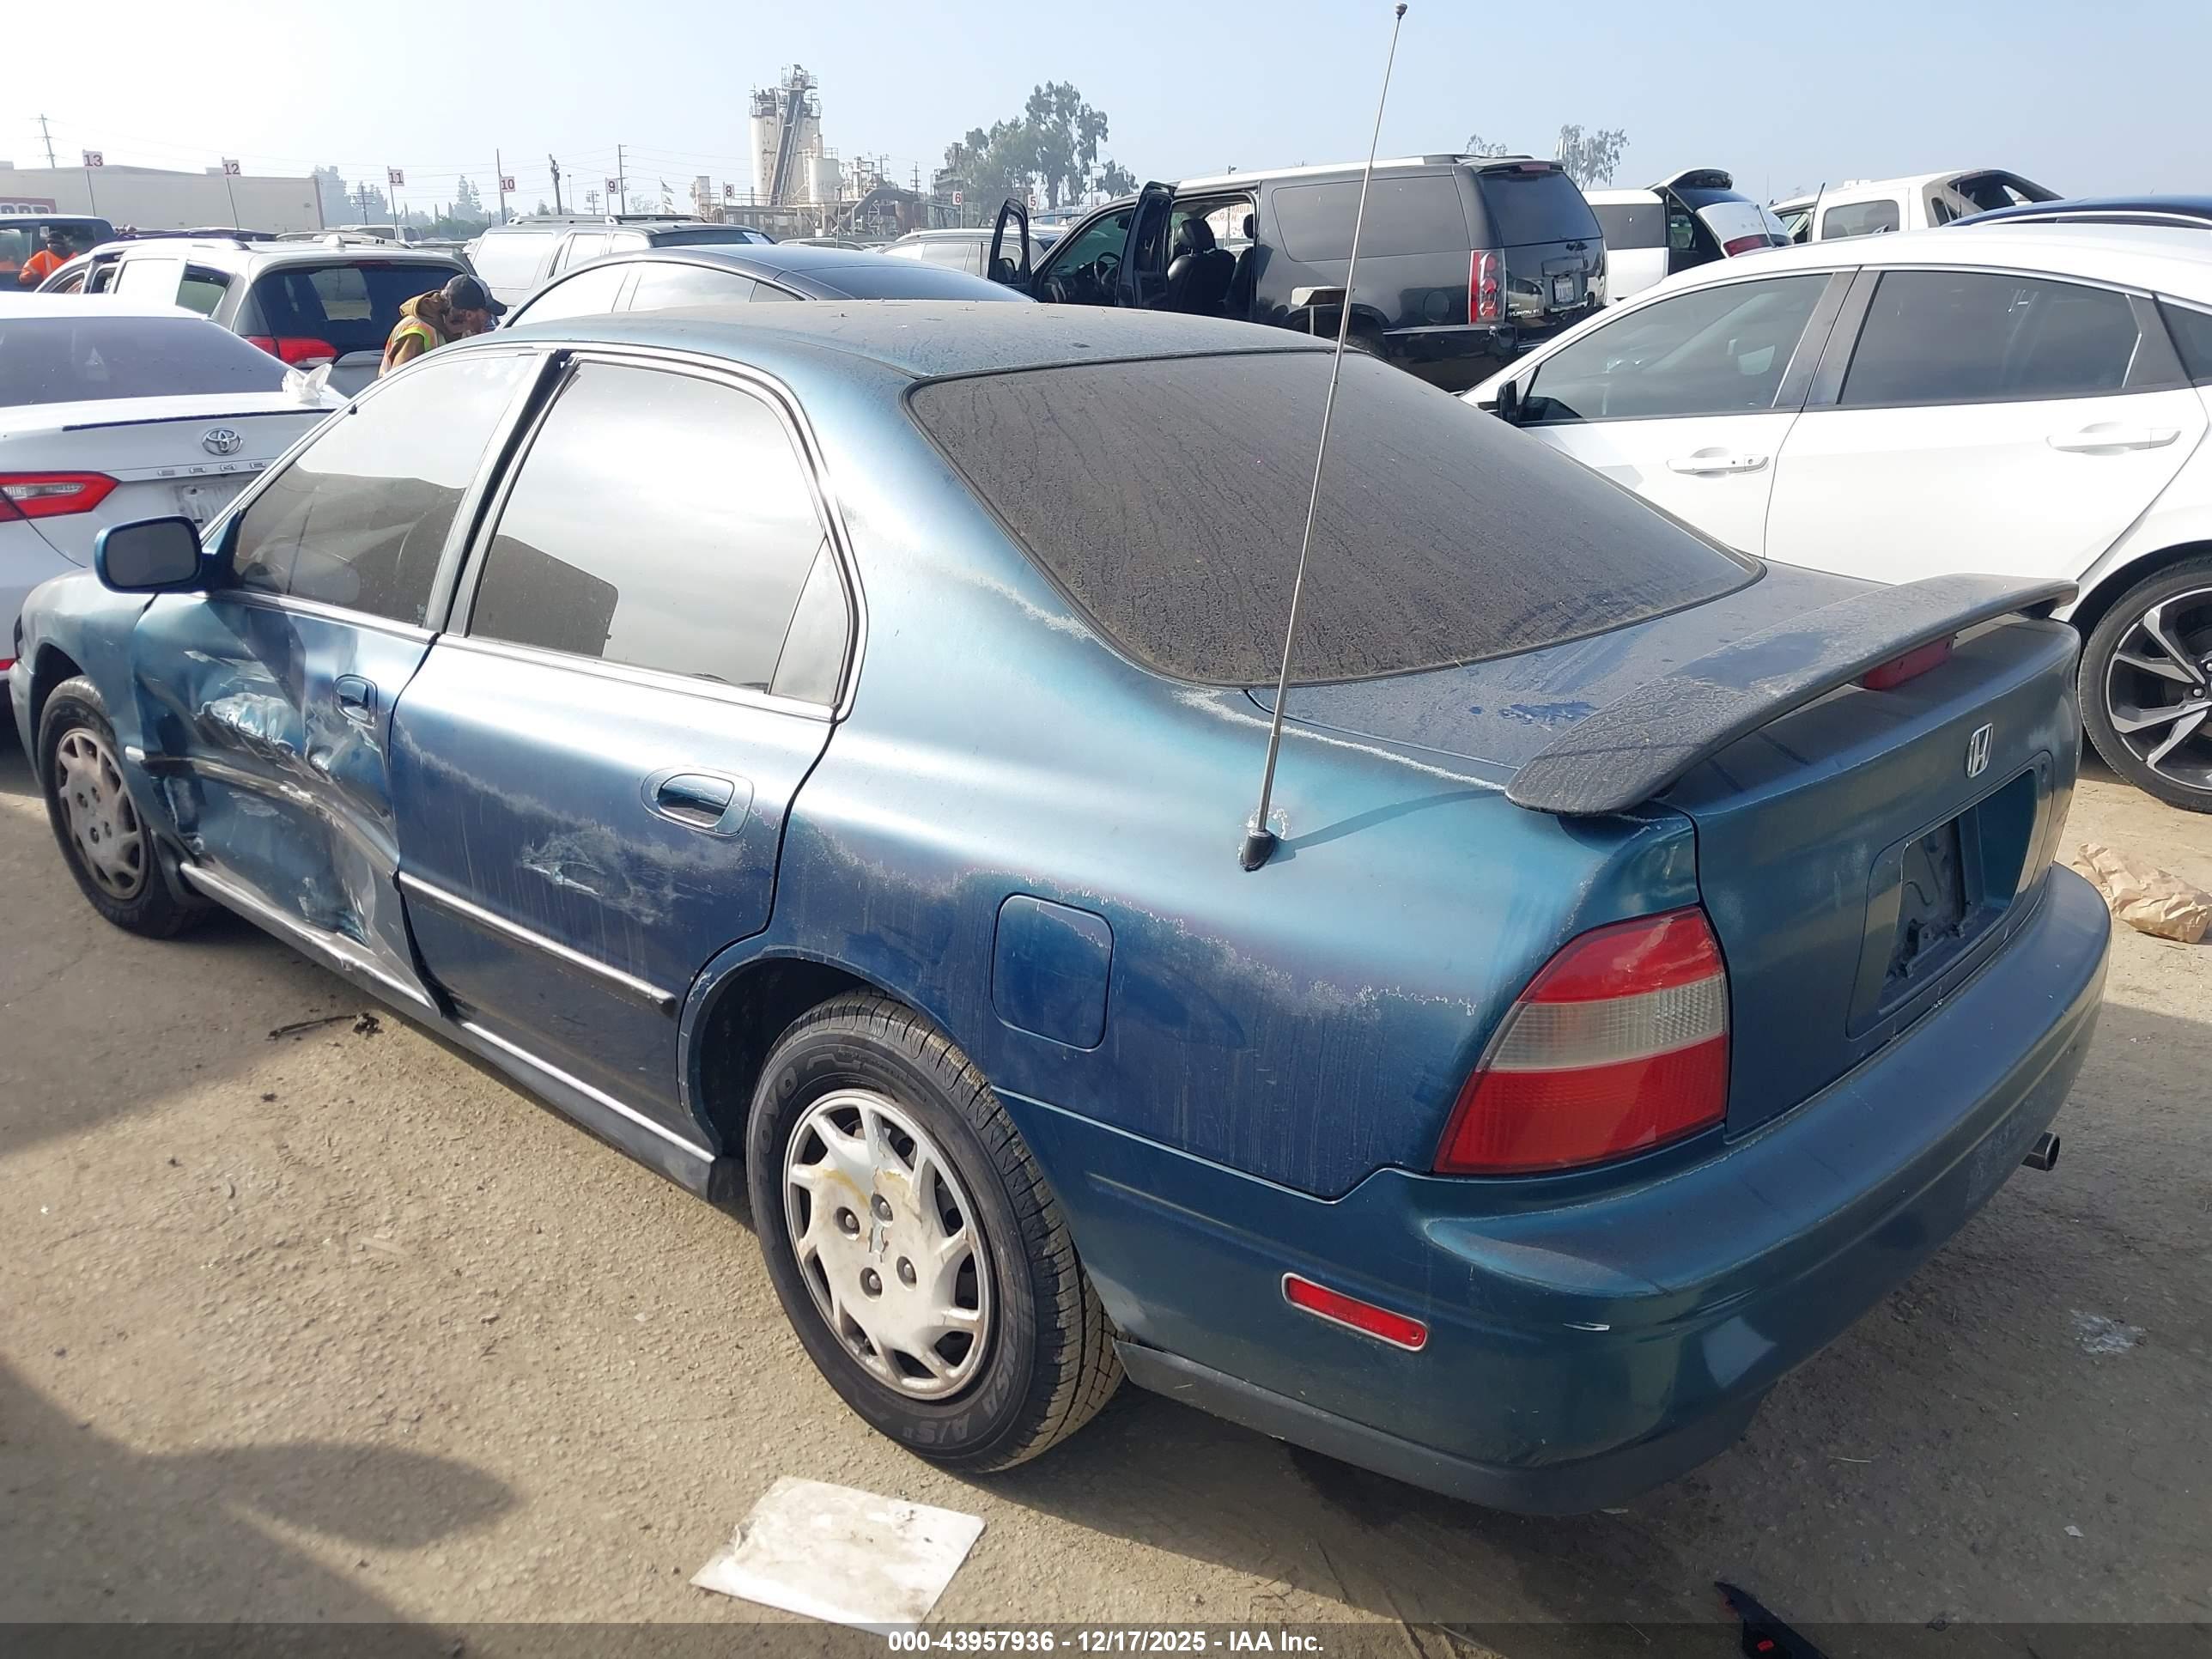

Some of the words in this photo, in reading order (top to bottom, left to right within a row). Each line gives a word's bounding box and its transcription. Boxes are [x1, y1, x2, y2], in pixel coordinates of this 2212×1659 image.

[84, 155, 103, 167] 13
[222, 163, 240, 174] 12
[389, 172, 404, 184] 11
[501, 179, 514, 190] 10
[608, 180, 616, 192] 9
[726, 185, 732, 197] 8
[955, 192, 961, 203] 6
[1030, 197, 1036, 206] 5
